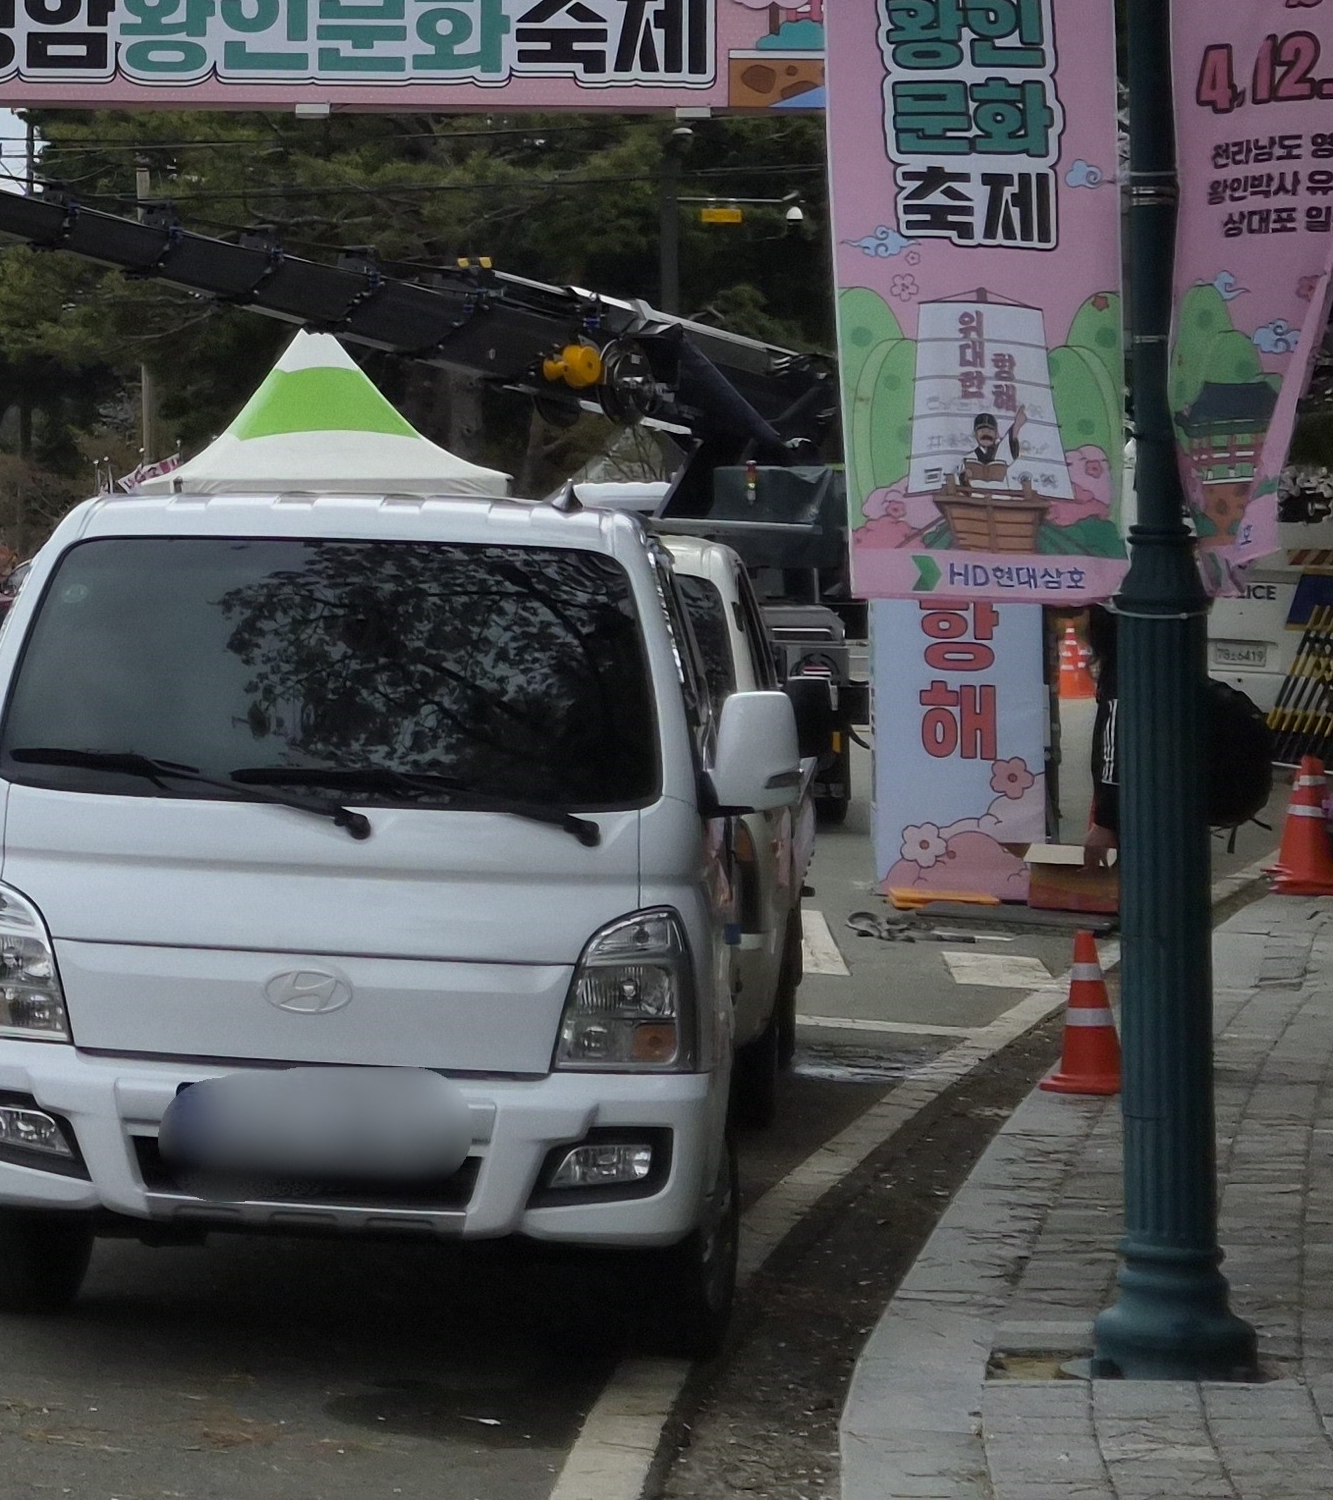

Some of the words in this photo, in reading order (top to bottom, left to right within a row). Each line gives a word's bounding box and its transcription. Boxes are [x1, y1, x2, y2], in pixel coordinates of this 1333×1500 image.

[894, 79, 1053, 155] 문화
[1211, 134, 1303, 169] 전라남도
[902, 168, 1052, 243] 축제
[1207, 171, 1300, 205] 왕인박사
[1223, 207, 1297, 237] 상대포
[958, 310, 986, 399] 위대한
[949, 563, 1087, 591] HD현대삼호
